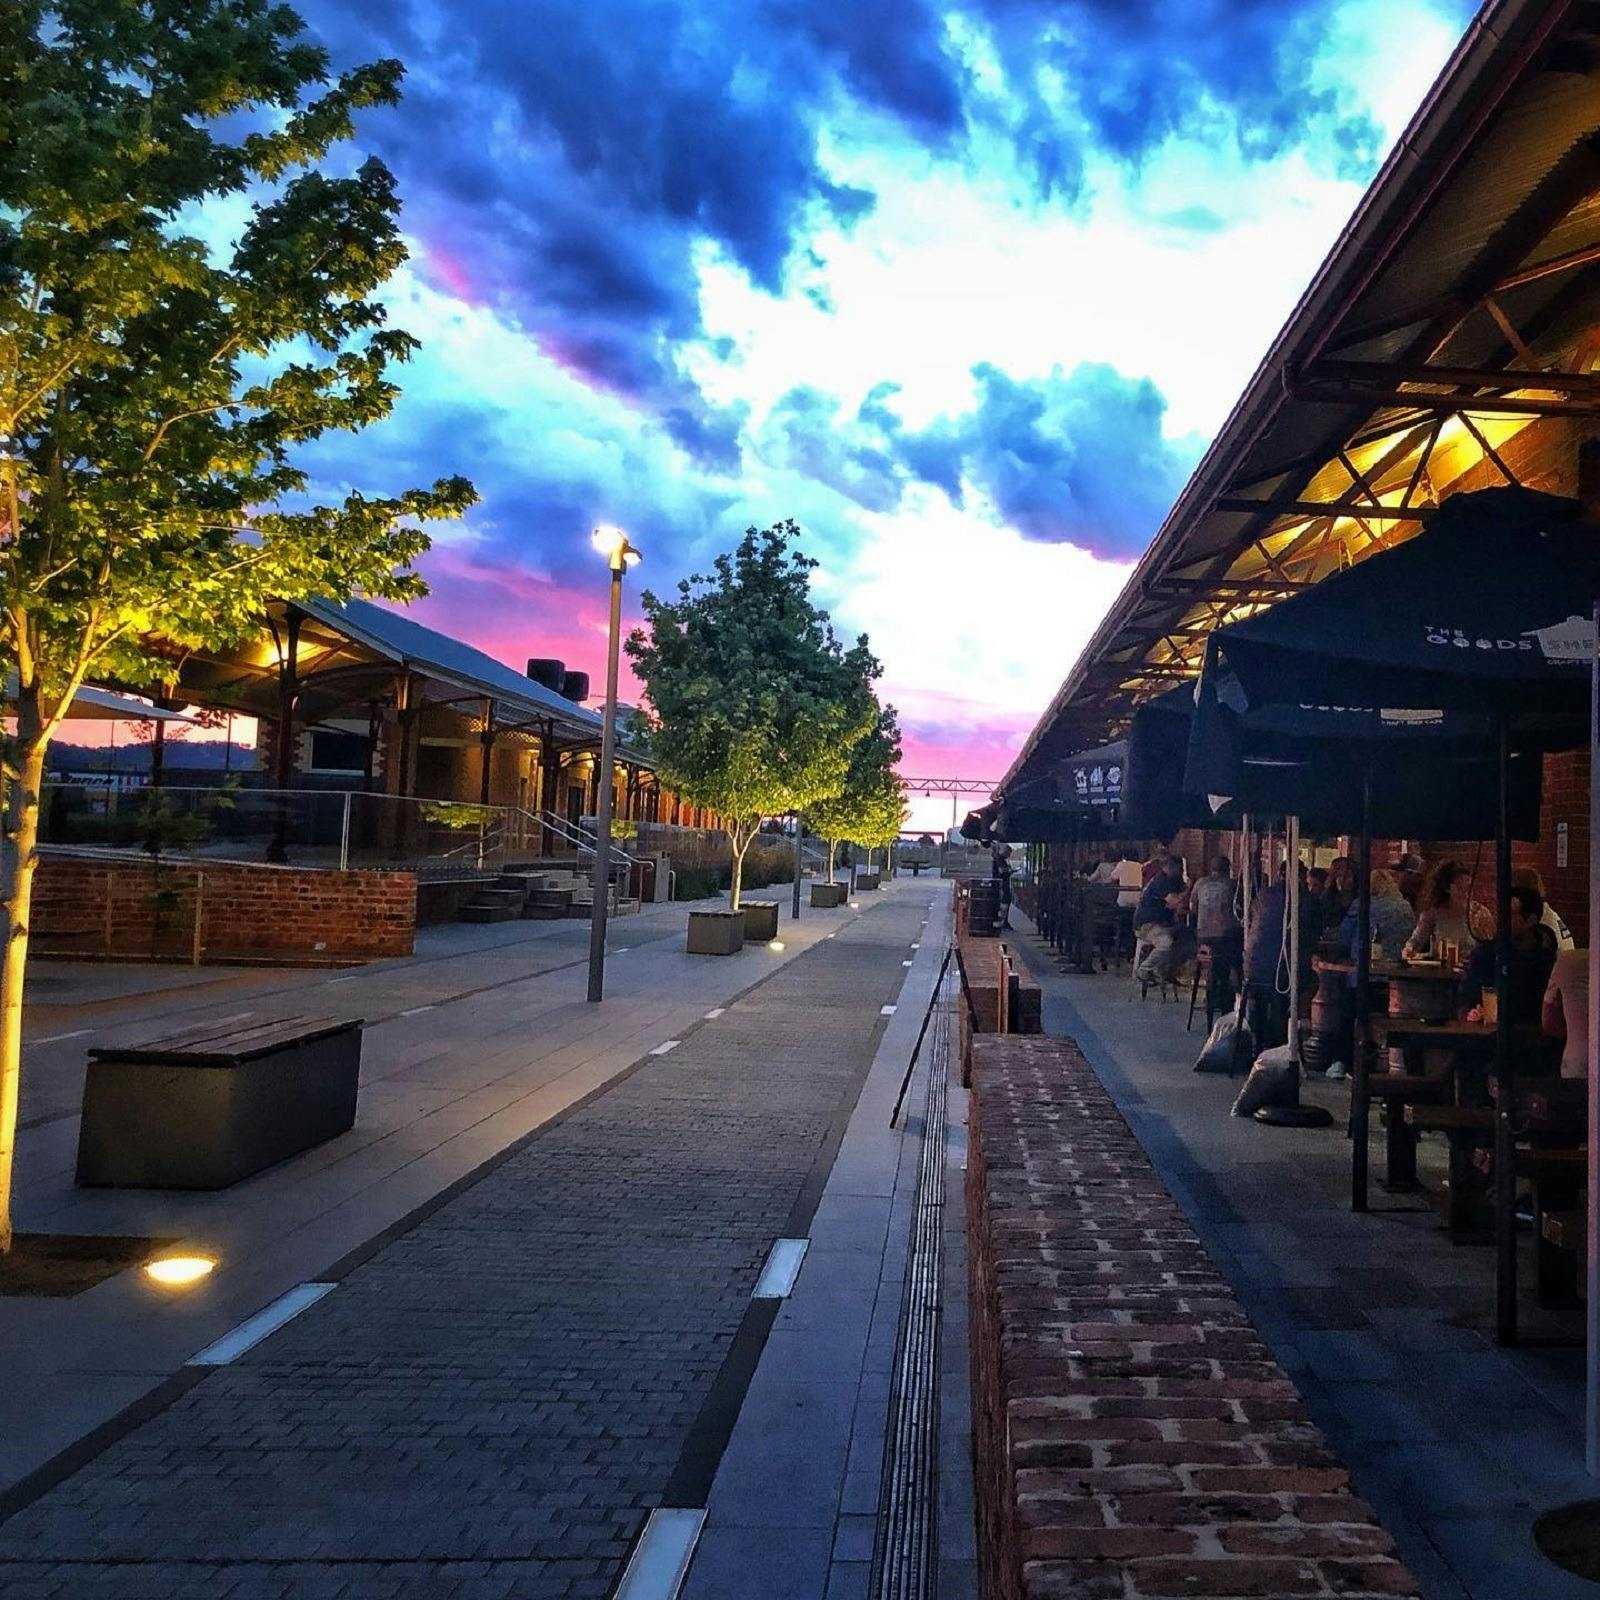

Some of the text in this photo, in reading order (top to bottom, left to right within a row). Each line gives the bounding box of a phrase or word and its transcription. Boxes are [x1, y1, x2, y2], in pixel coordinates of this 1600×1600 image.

[1424, 626, 1463, 638] THE
[1426, 635, 1590, 650] GOODS SHE
